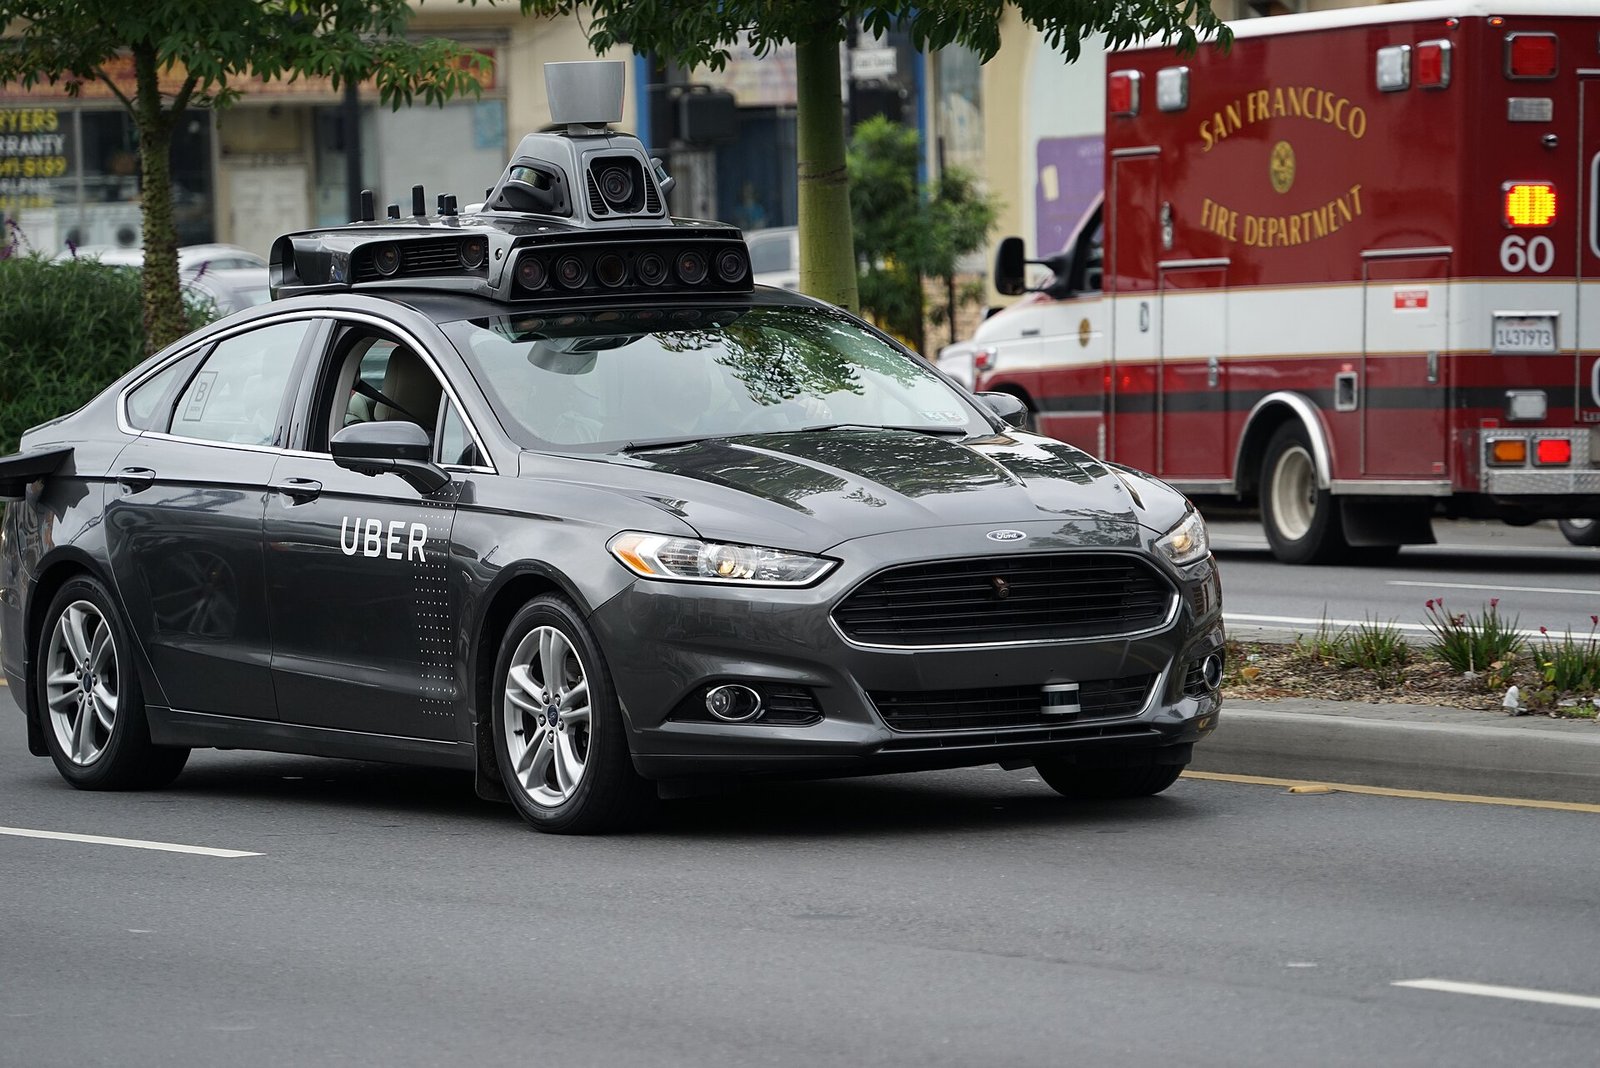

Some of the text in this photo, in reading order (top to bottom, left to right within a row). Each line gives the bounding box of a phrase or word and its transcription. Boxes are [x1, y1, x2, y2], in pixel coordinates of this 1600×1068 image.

[1200, 86, 1367, 152] SAN FRANCISCO
[1201, 184, 1362, 248] FIRE DEPARTMENT
[1500, 234, 1555, 273] 60
[1498, 329, 1551, 346] 1437973
[340, 516, 428, 563] UBER
